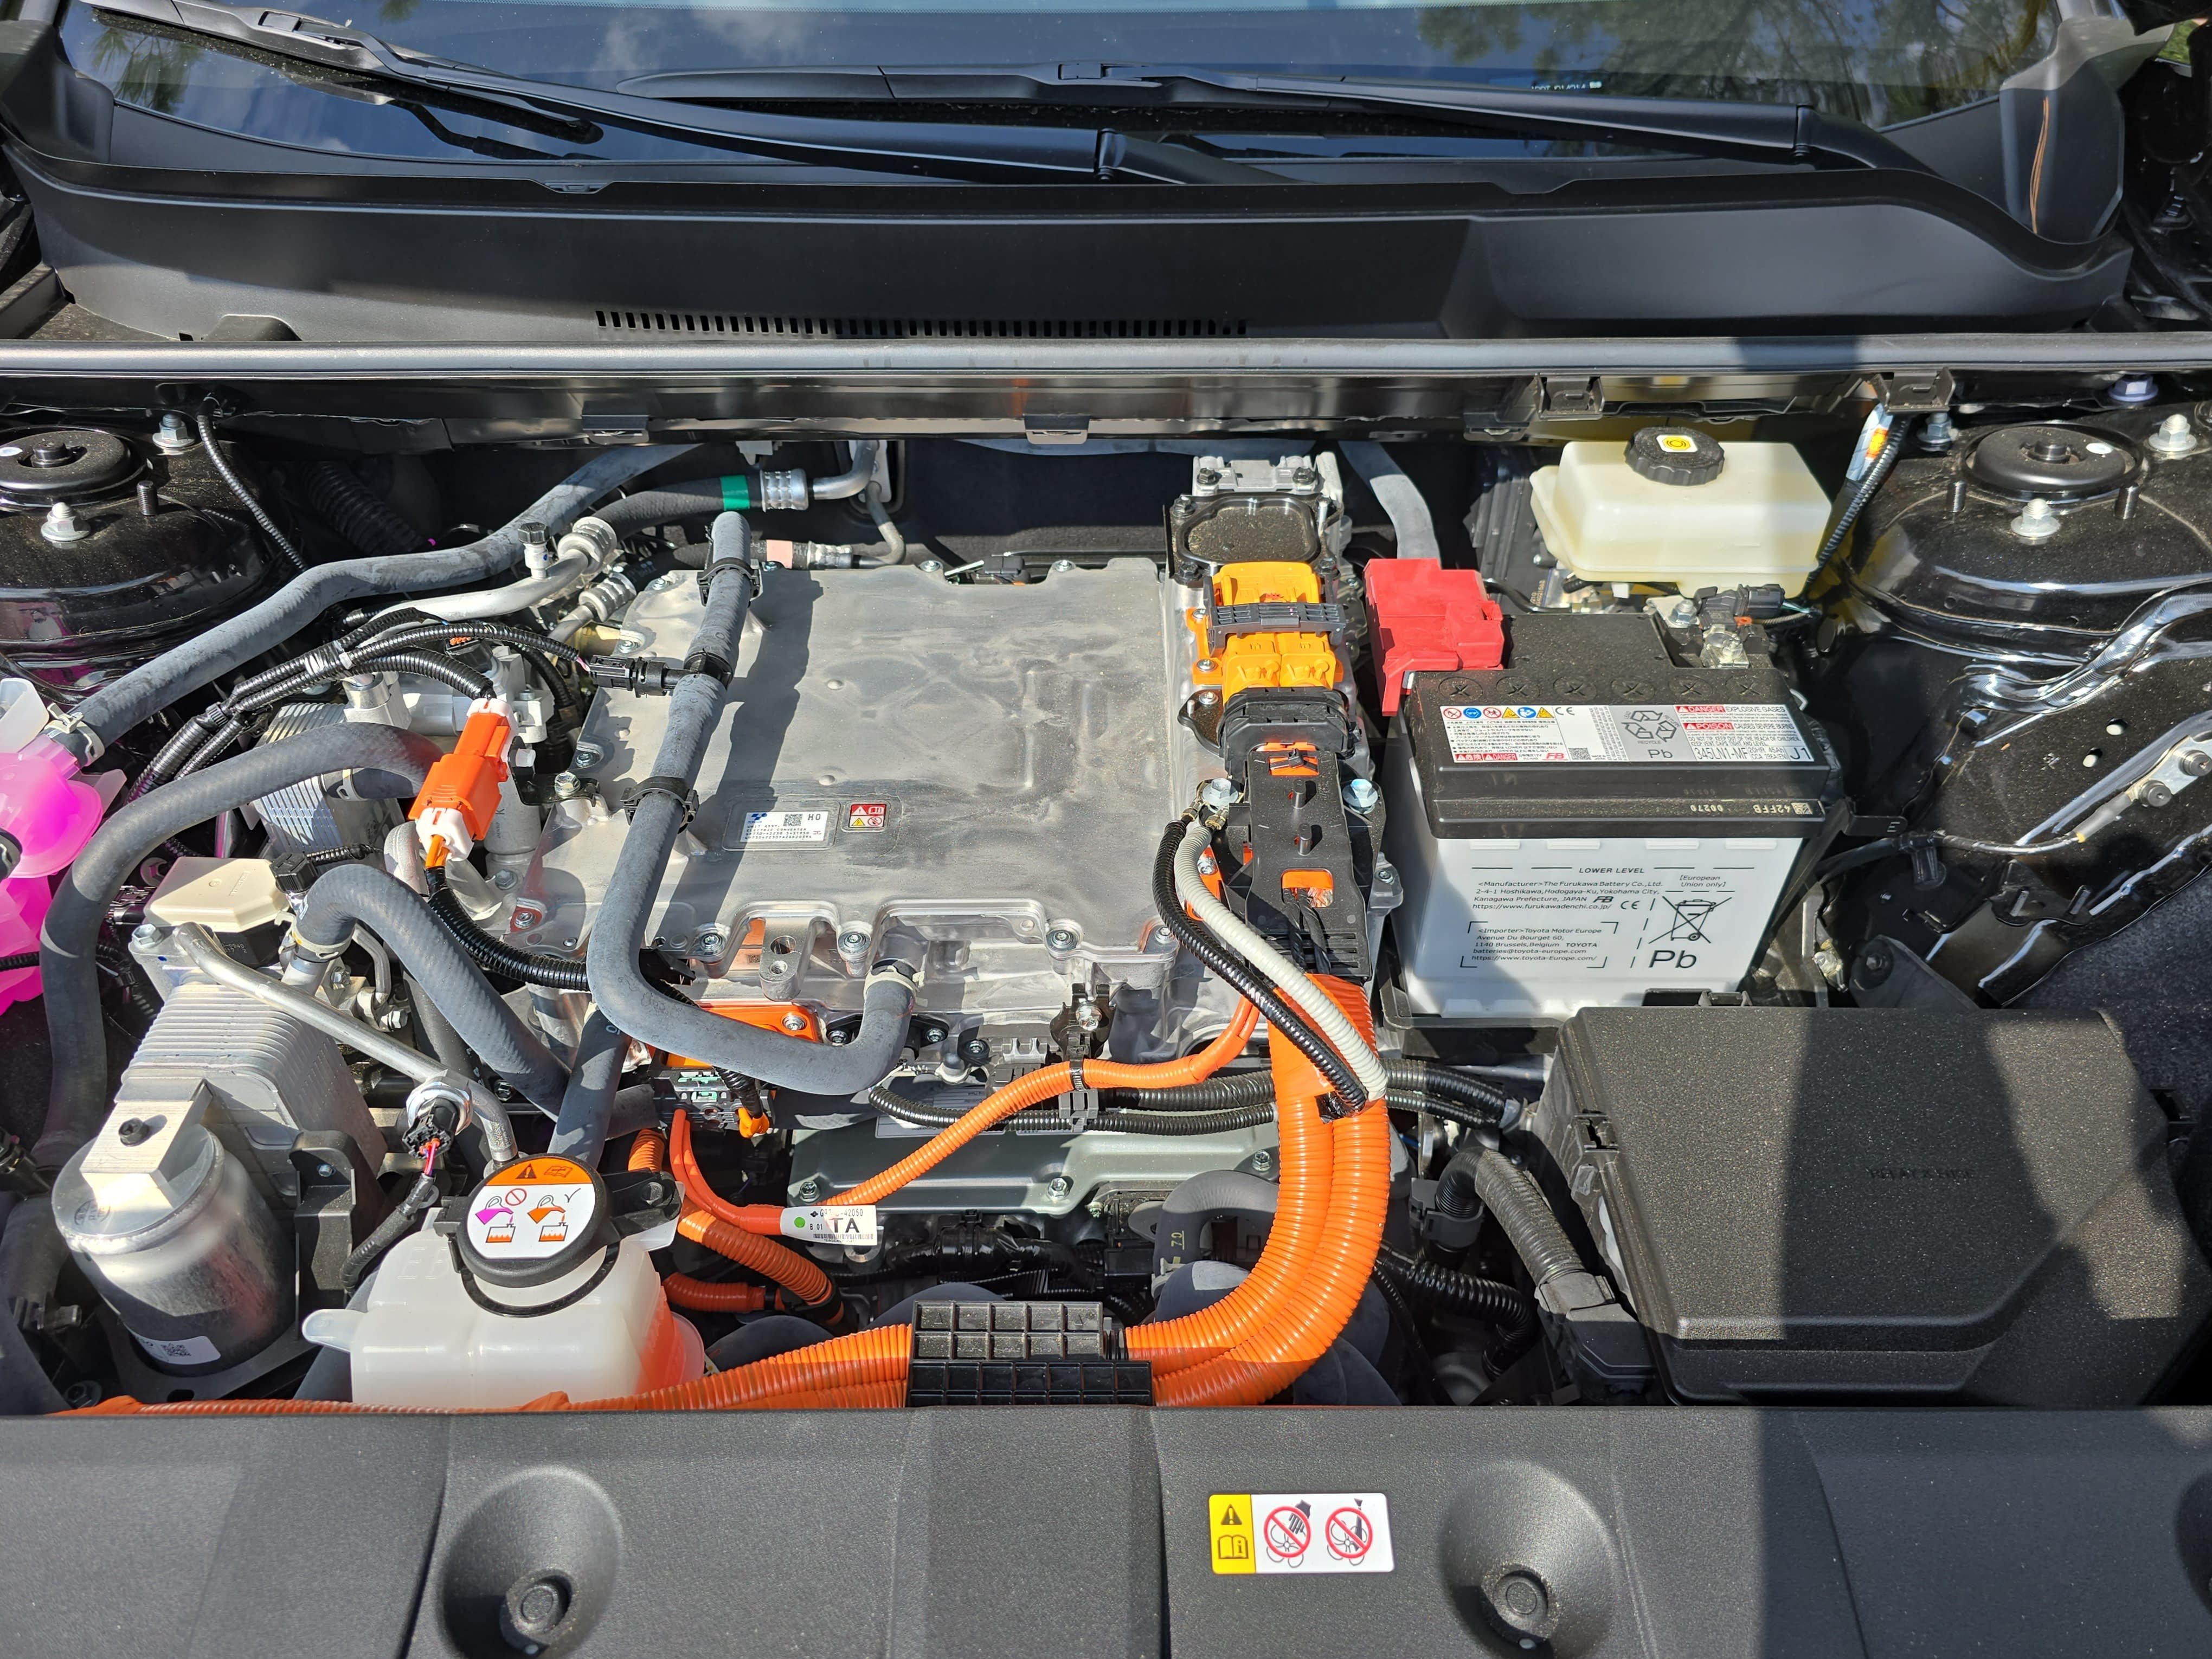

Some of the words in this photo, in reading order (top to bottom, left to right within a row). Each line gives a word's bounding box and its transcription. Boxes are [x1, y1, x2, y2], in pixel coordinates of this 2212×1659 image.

[1648, 749, 1673, 758] Pb
[1694, 748, 1747, 760] 345LN1-MF
[1790, 747, 1811, 760] J1
[1690, 804, 1725, 813] 00270
[1752, 804, 1791, 814] 42FFB
[1648, 949, 1697, 969] Pb
[829, 1218, 860, 1233] TA
